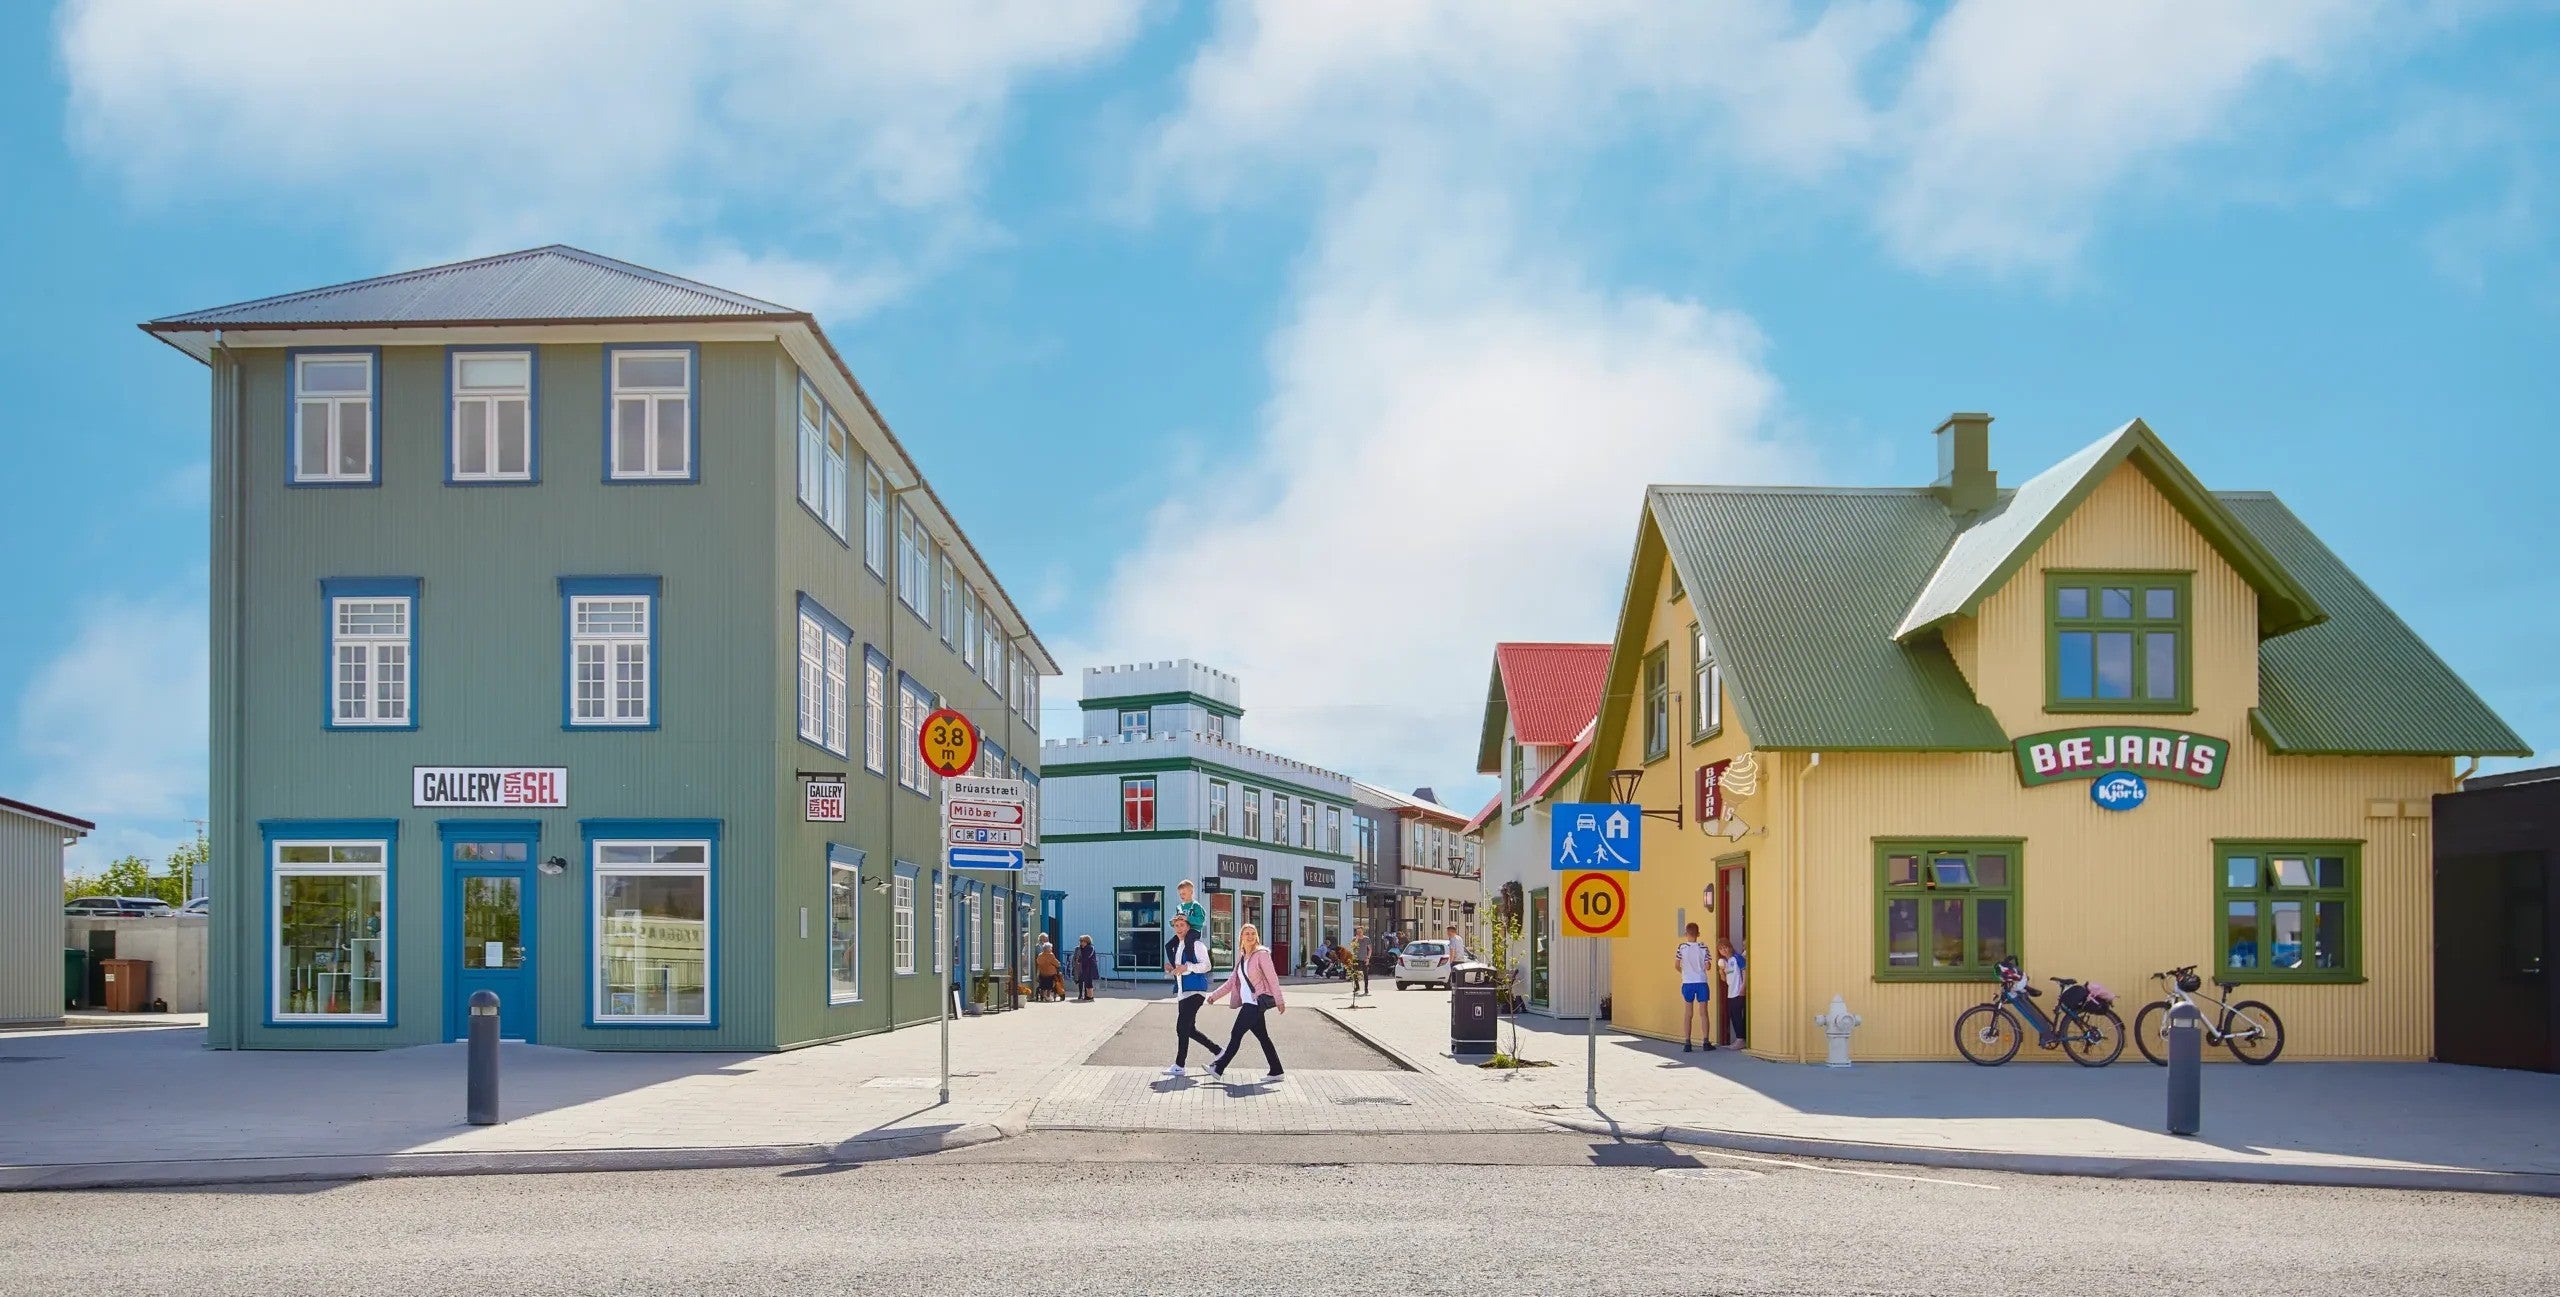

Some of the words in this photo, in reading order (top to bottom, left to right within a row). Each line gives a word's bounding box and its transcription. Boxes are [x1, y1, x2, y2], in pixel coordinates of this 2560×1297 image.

[933, 725, 964, 747] 3,8
[941, 749, 955, 760] m
[2029, 735, 2216, 774] BÆJARÍS
[423, 773, 501, 802] GALLERY
[503, 771, 521, 804] LISTA
[523, 771, 559, 804] SEL
[810, 785, 843, 798] GALLERY
[955, 783, 1018, 796] Brúarstræti
[809, 798, 820, 817] LISTA
[821, 799, 842, 818] SEL
[954, 806, 997, 818] Miðbær
[1222, 861, 1255, 875] MOTIVO
[1580, 892, 1611, 915] 10
